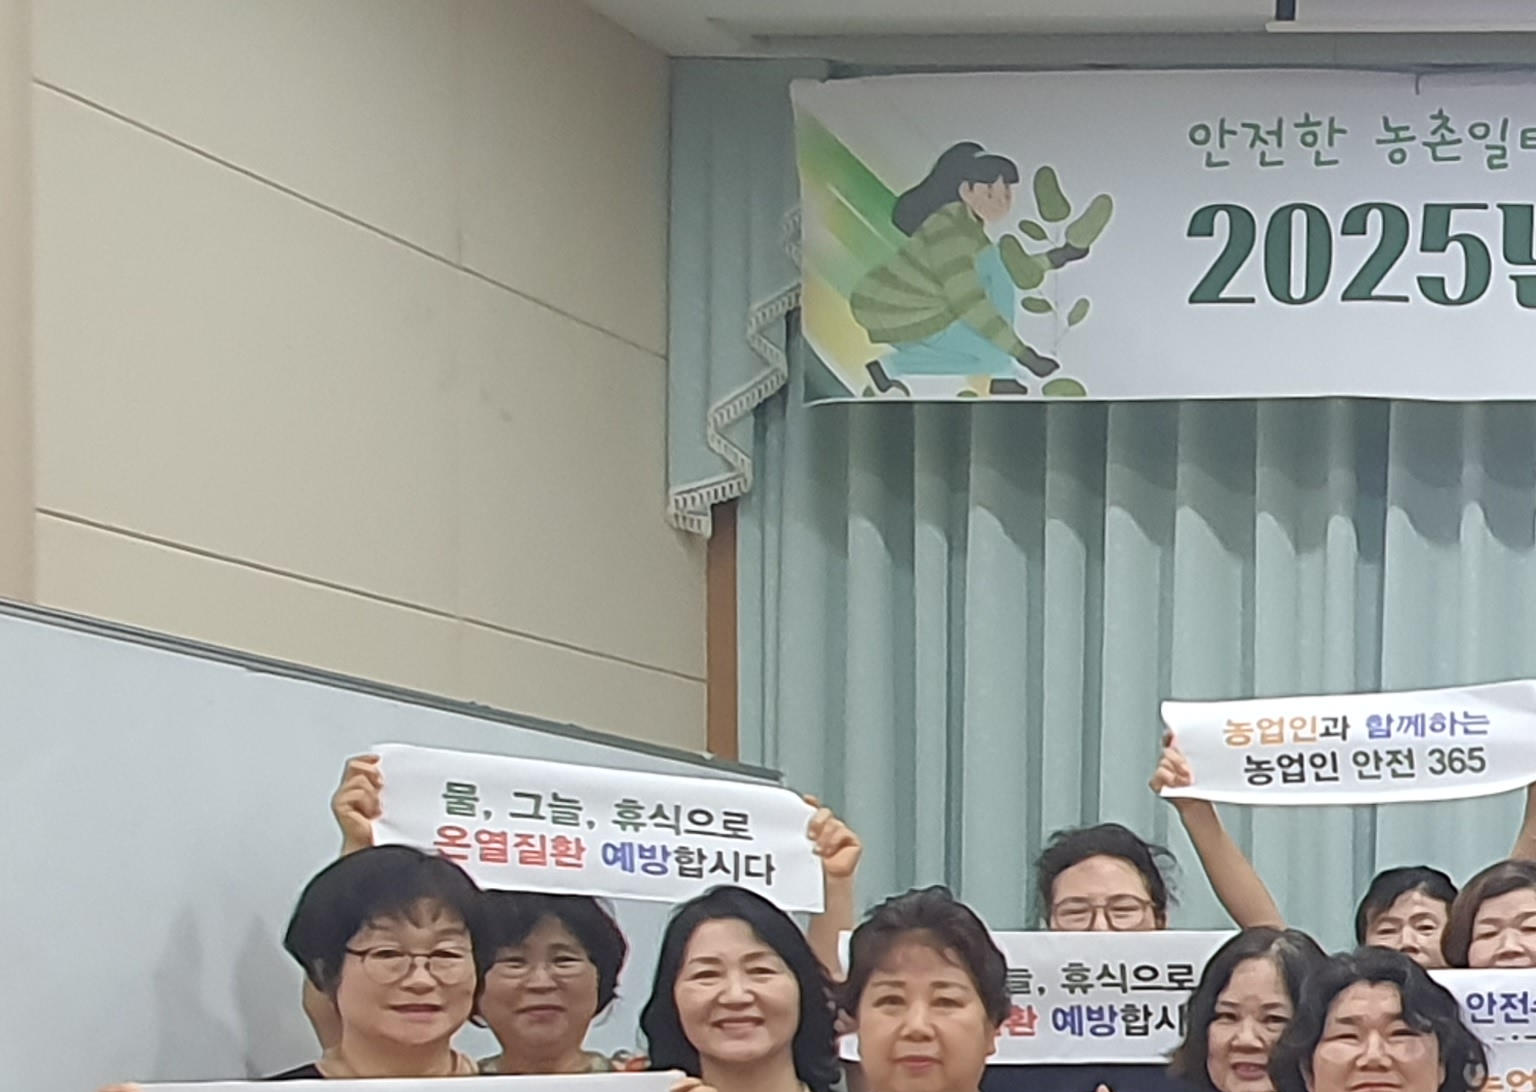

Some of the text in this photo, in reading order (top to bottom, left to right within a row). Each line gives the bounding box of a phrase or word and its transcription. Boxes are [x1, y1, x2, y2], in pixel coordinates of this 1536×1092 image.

[1188, 112, 1348, 168] 안전한
[1222, 710, 1491, 747] 농업인과 함께하는
[1244, 747, 1486, 786] 농업인 안전 365
[442, 781, 754, 841] 물, 그늘, 휴식으로
[433, 825, 776, 886] 온열질환 예방합시다
[1061, 962, 1199, 995] 휴식으로
[1052, 1004, 1185, 1037] 예방합시
